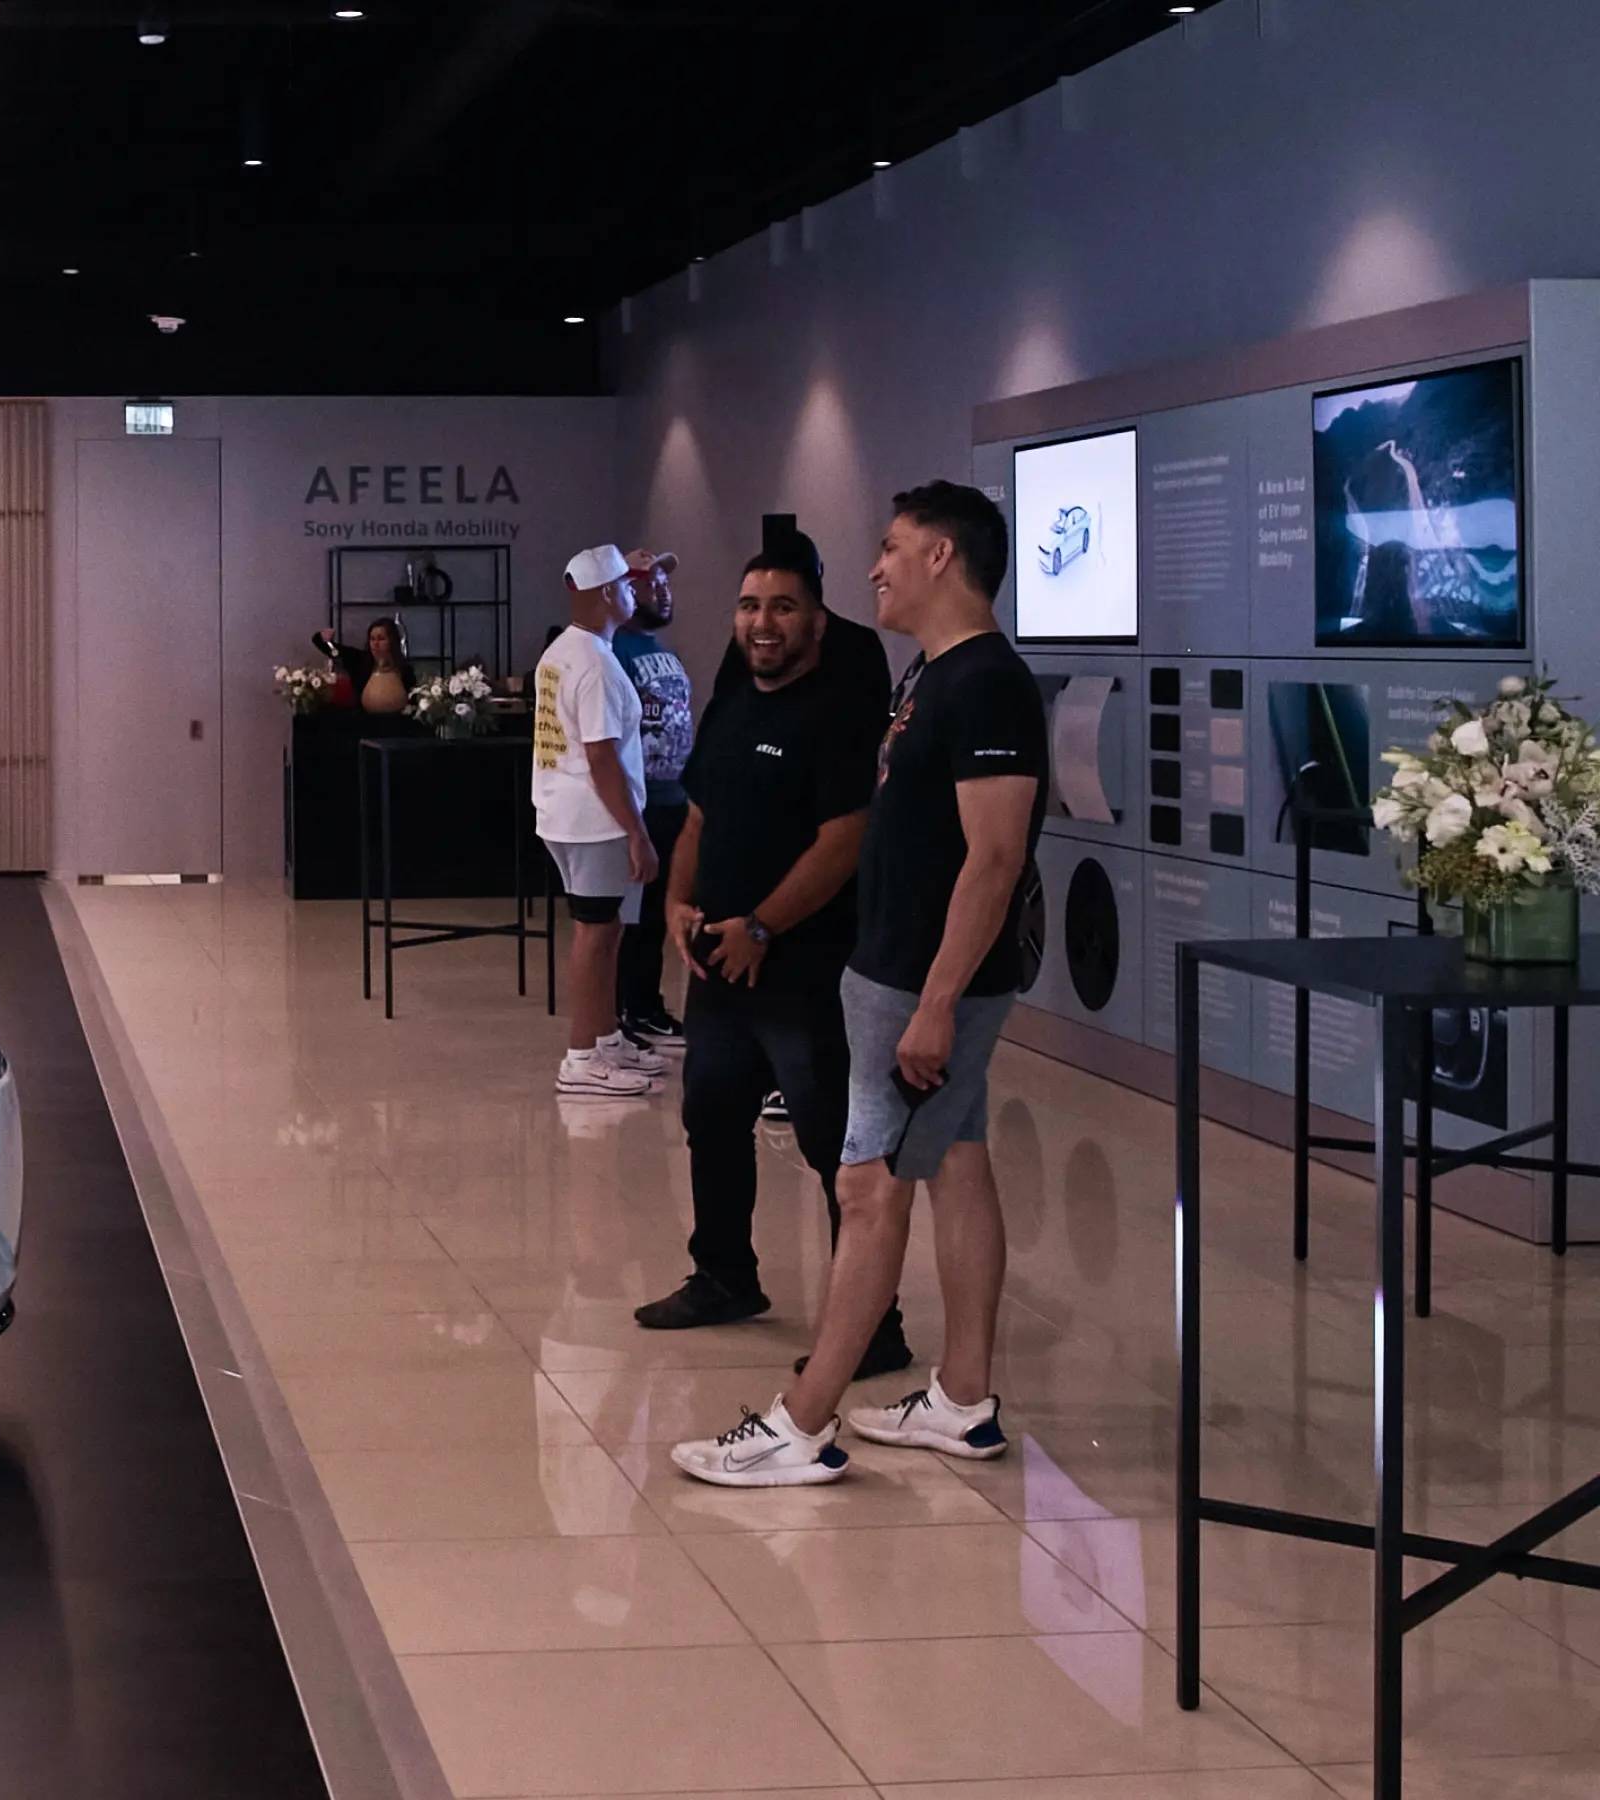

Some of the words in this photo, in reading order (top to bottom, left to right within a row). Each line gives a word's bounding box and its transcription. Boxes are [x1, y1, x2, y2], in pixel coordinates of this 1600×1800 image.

[304, 465, 521, 504] AFEELA
[304, 520, 354, 541] Sony
[361, 519, 429, 537] Honda
[435, 519, 521, 540] Mobility
